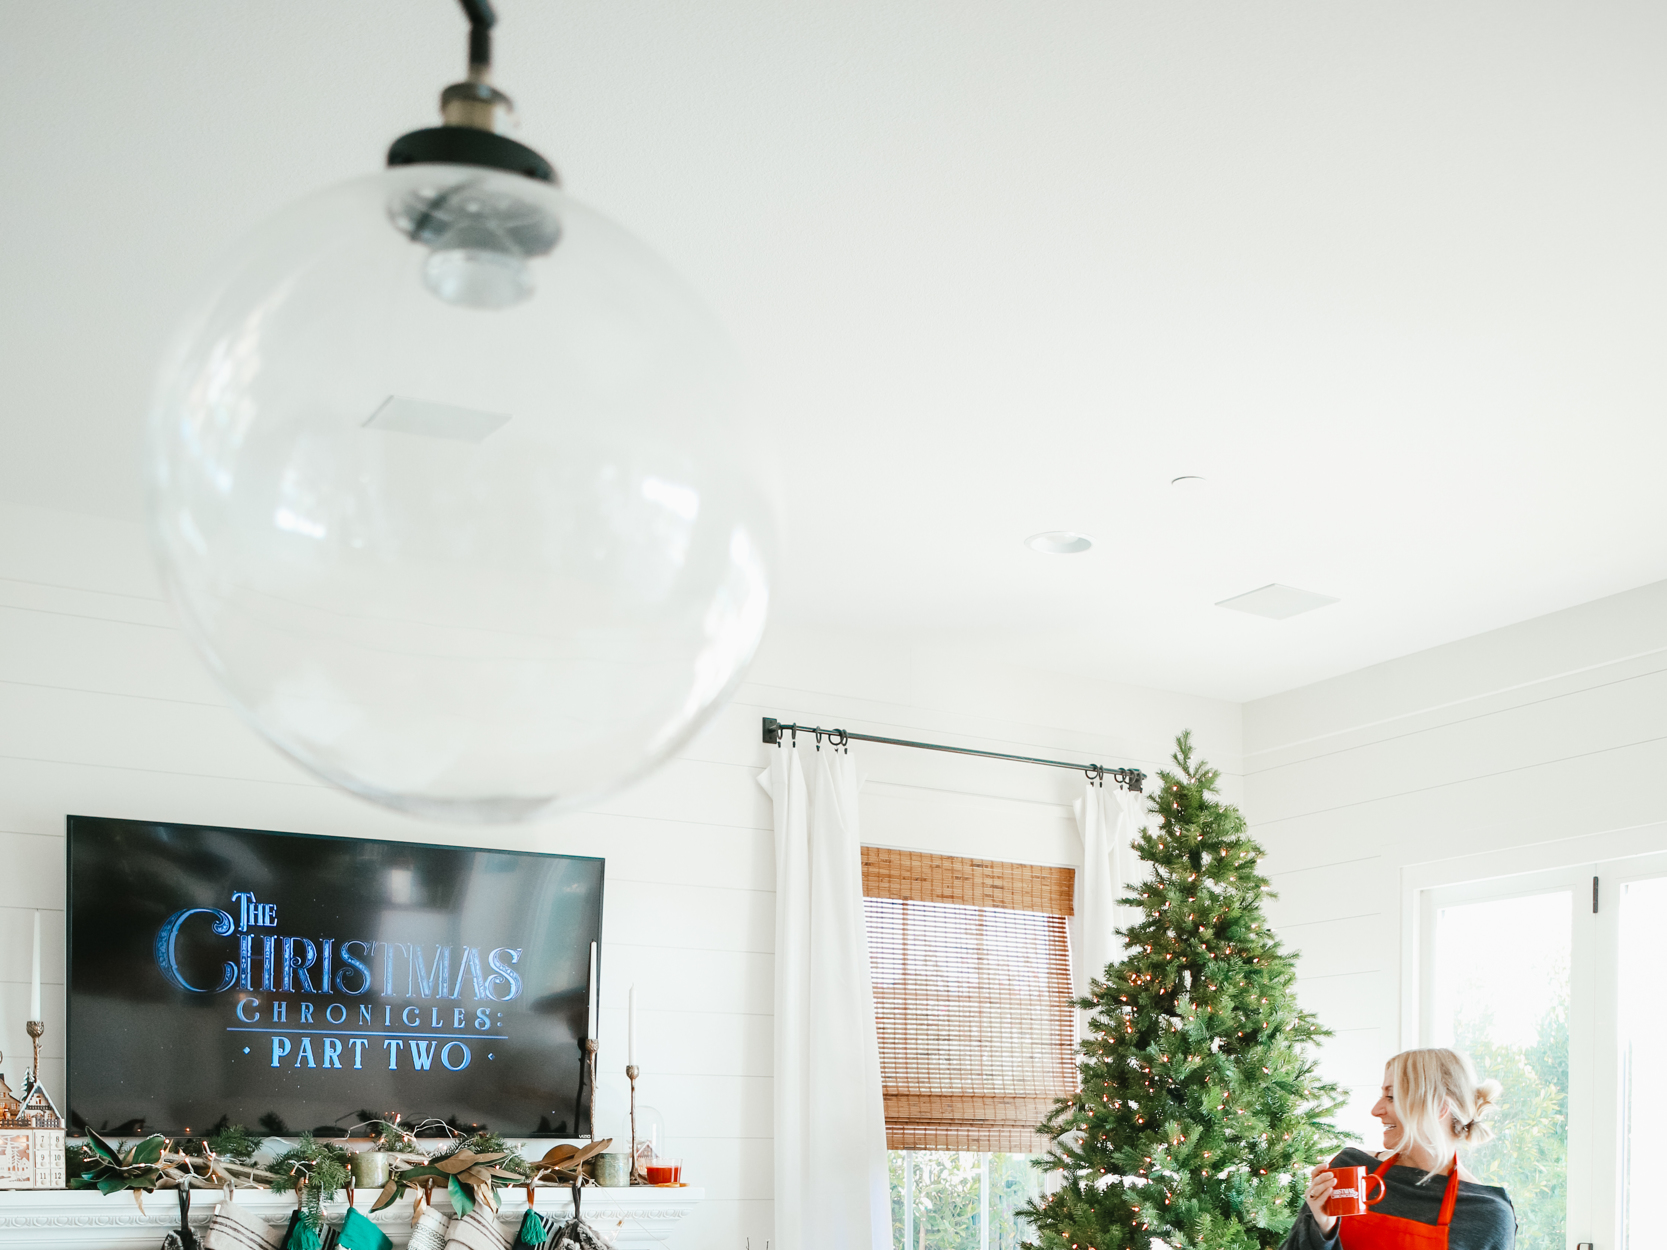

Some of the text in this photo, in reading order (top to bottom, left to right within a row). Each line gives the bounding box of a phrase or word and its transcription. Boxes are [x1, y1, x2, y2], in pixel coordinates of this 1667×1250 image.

[231, 891, 278, 932] THE
[154, 906, 524, 1002] CHRISTMAS
[270, 1036, 472, 1071] PART TWO
